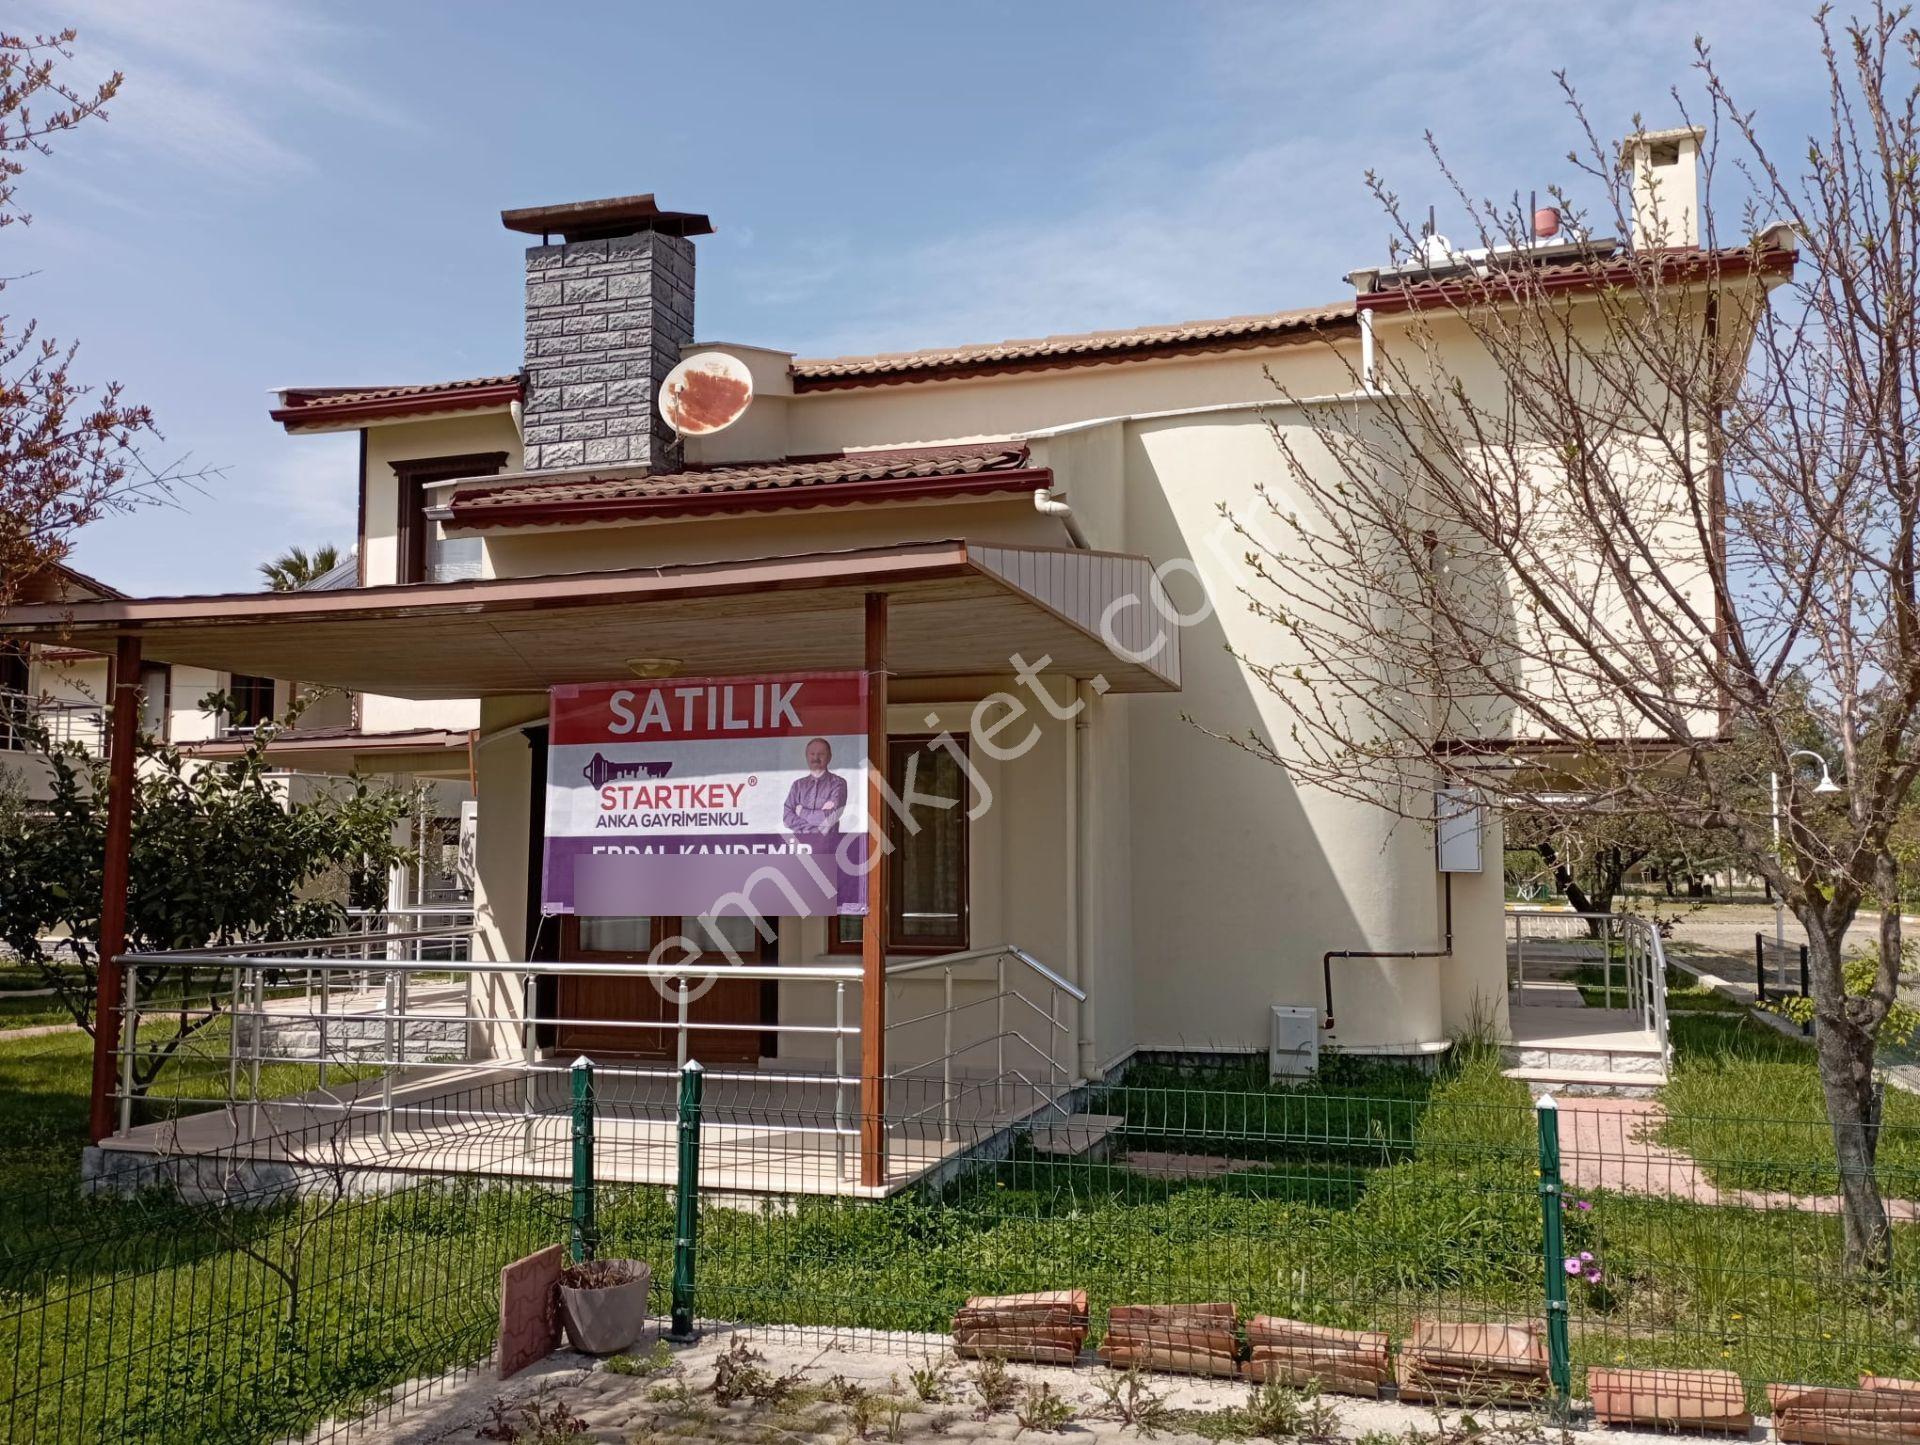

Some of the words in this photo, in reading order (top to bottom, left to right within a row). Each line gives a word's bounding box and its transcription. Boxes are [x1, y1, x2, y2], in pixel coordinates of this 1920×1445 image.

[607, 682, 804, 735] SATILIK
[595, 814, 639, 828] ANKA
[641, 810, 749, 828] GAYRİMENKUL
